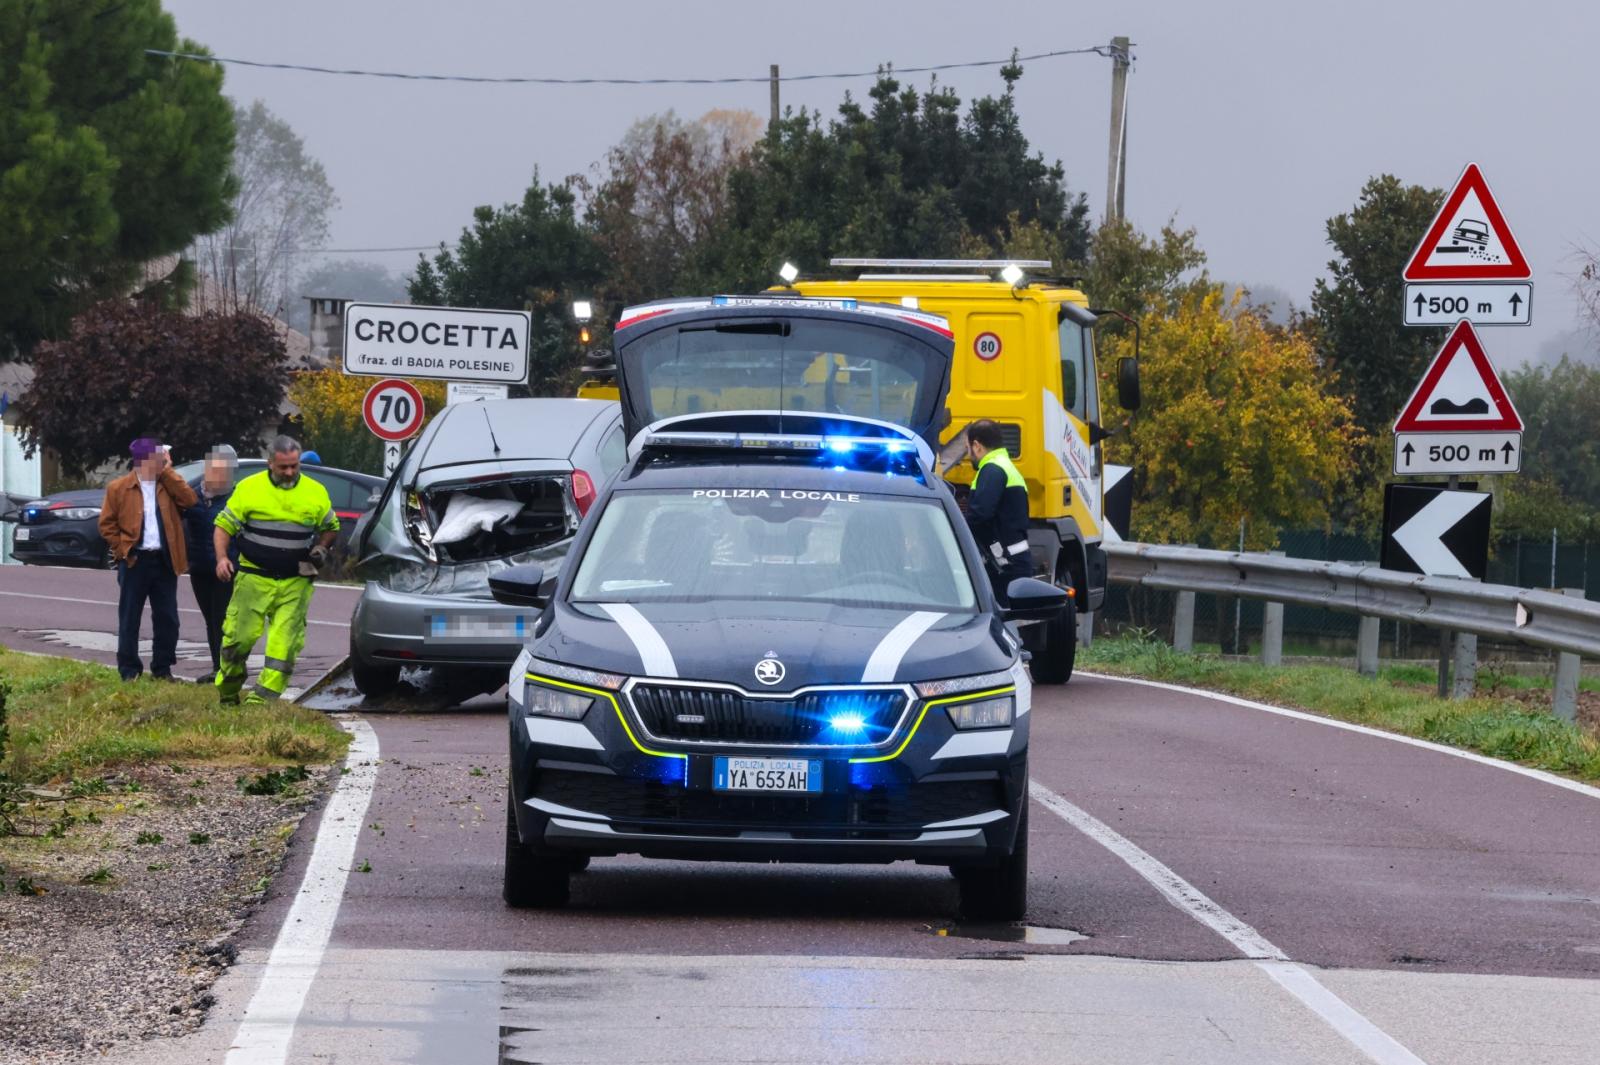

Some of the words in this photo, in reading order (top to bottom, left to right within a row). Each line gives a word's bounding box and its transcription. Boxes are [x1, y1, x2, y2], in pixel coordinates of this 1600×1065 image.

[1428, 296, 1469, 314] 500
[1477, 302, 1492, 314] m
[354, 318, 519, 350] CROCETTA
[980, 340, 995, 353] 80
[358, 354, 388, 367] (fraz.
[391, 356, 403, 367] di
[407, 357, 445, 369] BADIA
[449, 359, 515, 373] POLESINE)
[379, 395, 411, 424] 70
[1429, 444, 1470, 462] 500
[1478, 448, 1496, 461] m
[692, 489, 770, 499] POLIZIA
[780, 490, 861, 503] LOCALE
[734, 760, 765, 769] POLIZIA
[771, 761, 803, 770] LOCALE
[730, 769, 748, 788] YA
